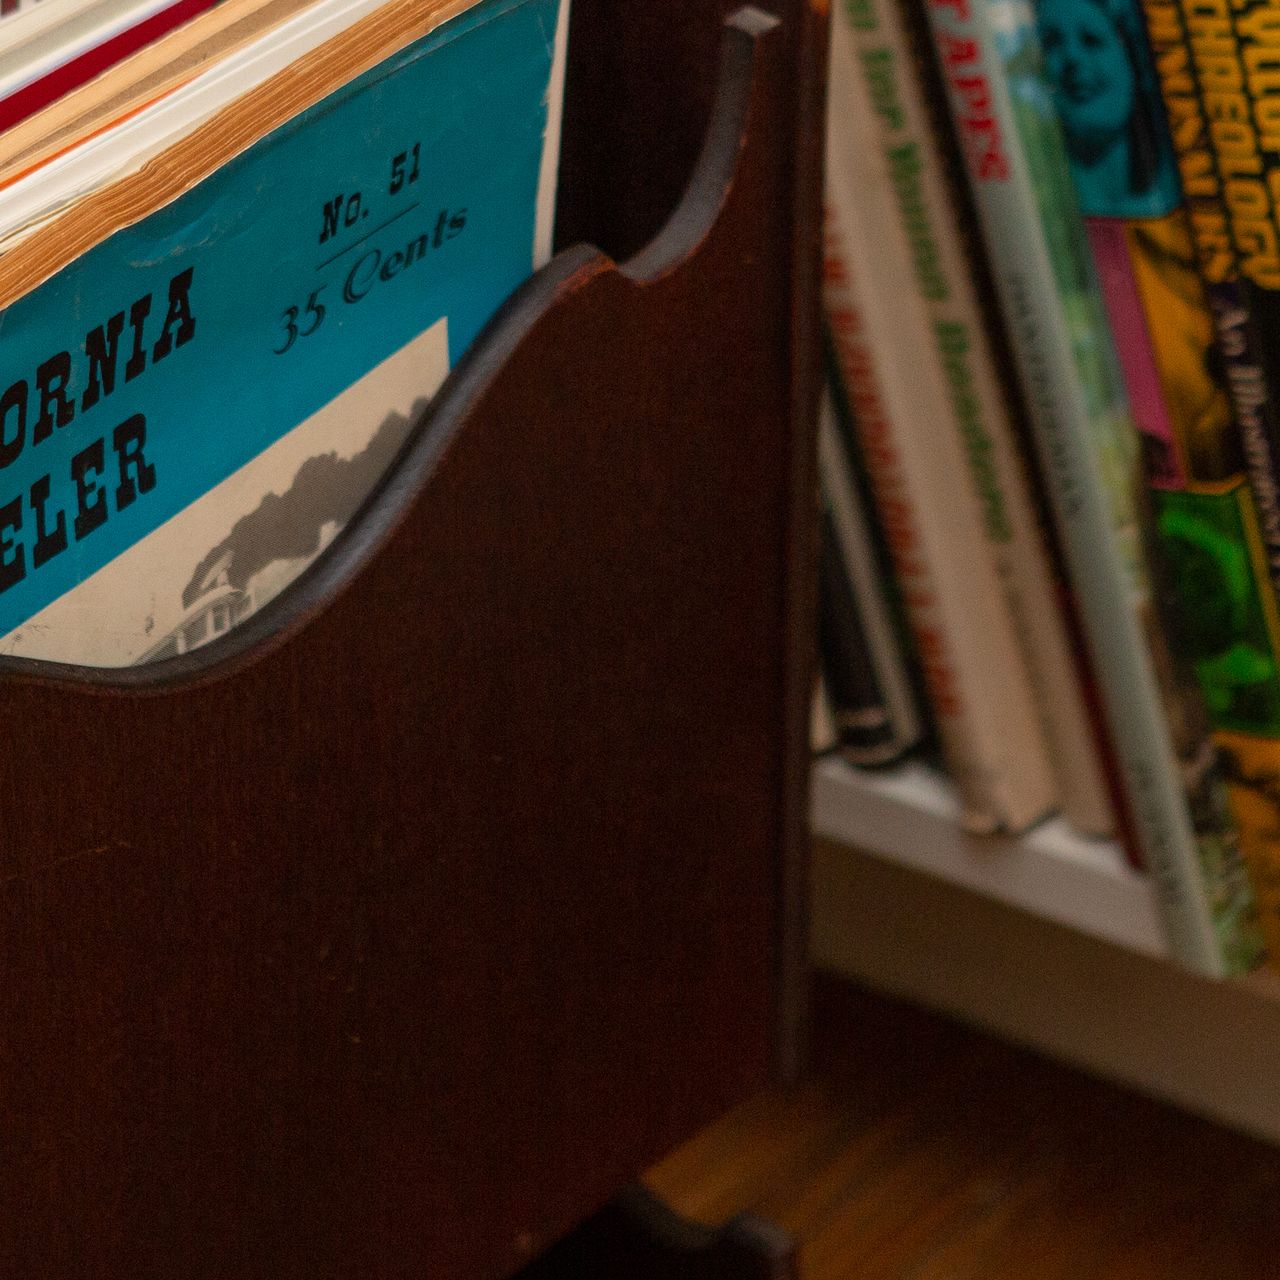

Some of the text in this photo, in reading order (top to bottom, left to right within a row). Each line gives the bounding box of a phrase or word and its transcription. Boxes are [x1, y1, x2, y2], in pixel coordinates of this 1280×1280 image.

[935, 35, 1010, 183] APES
[319, 141, 423, 245] No. 51
[887, 142, 951, 301] Young
[272, 202, 469, 355] 35 Cents
[1219, 307, 1251, 356] An
